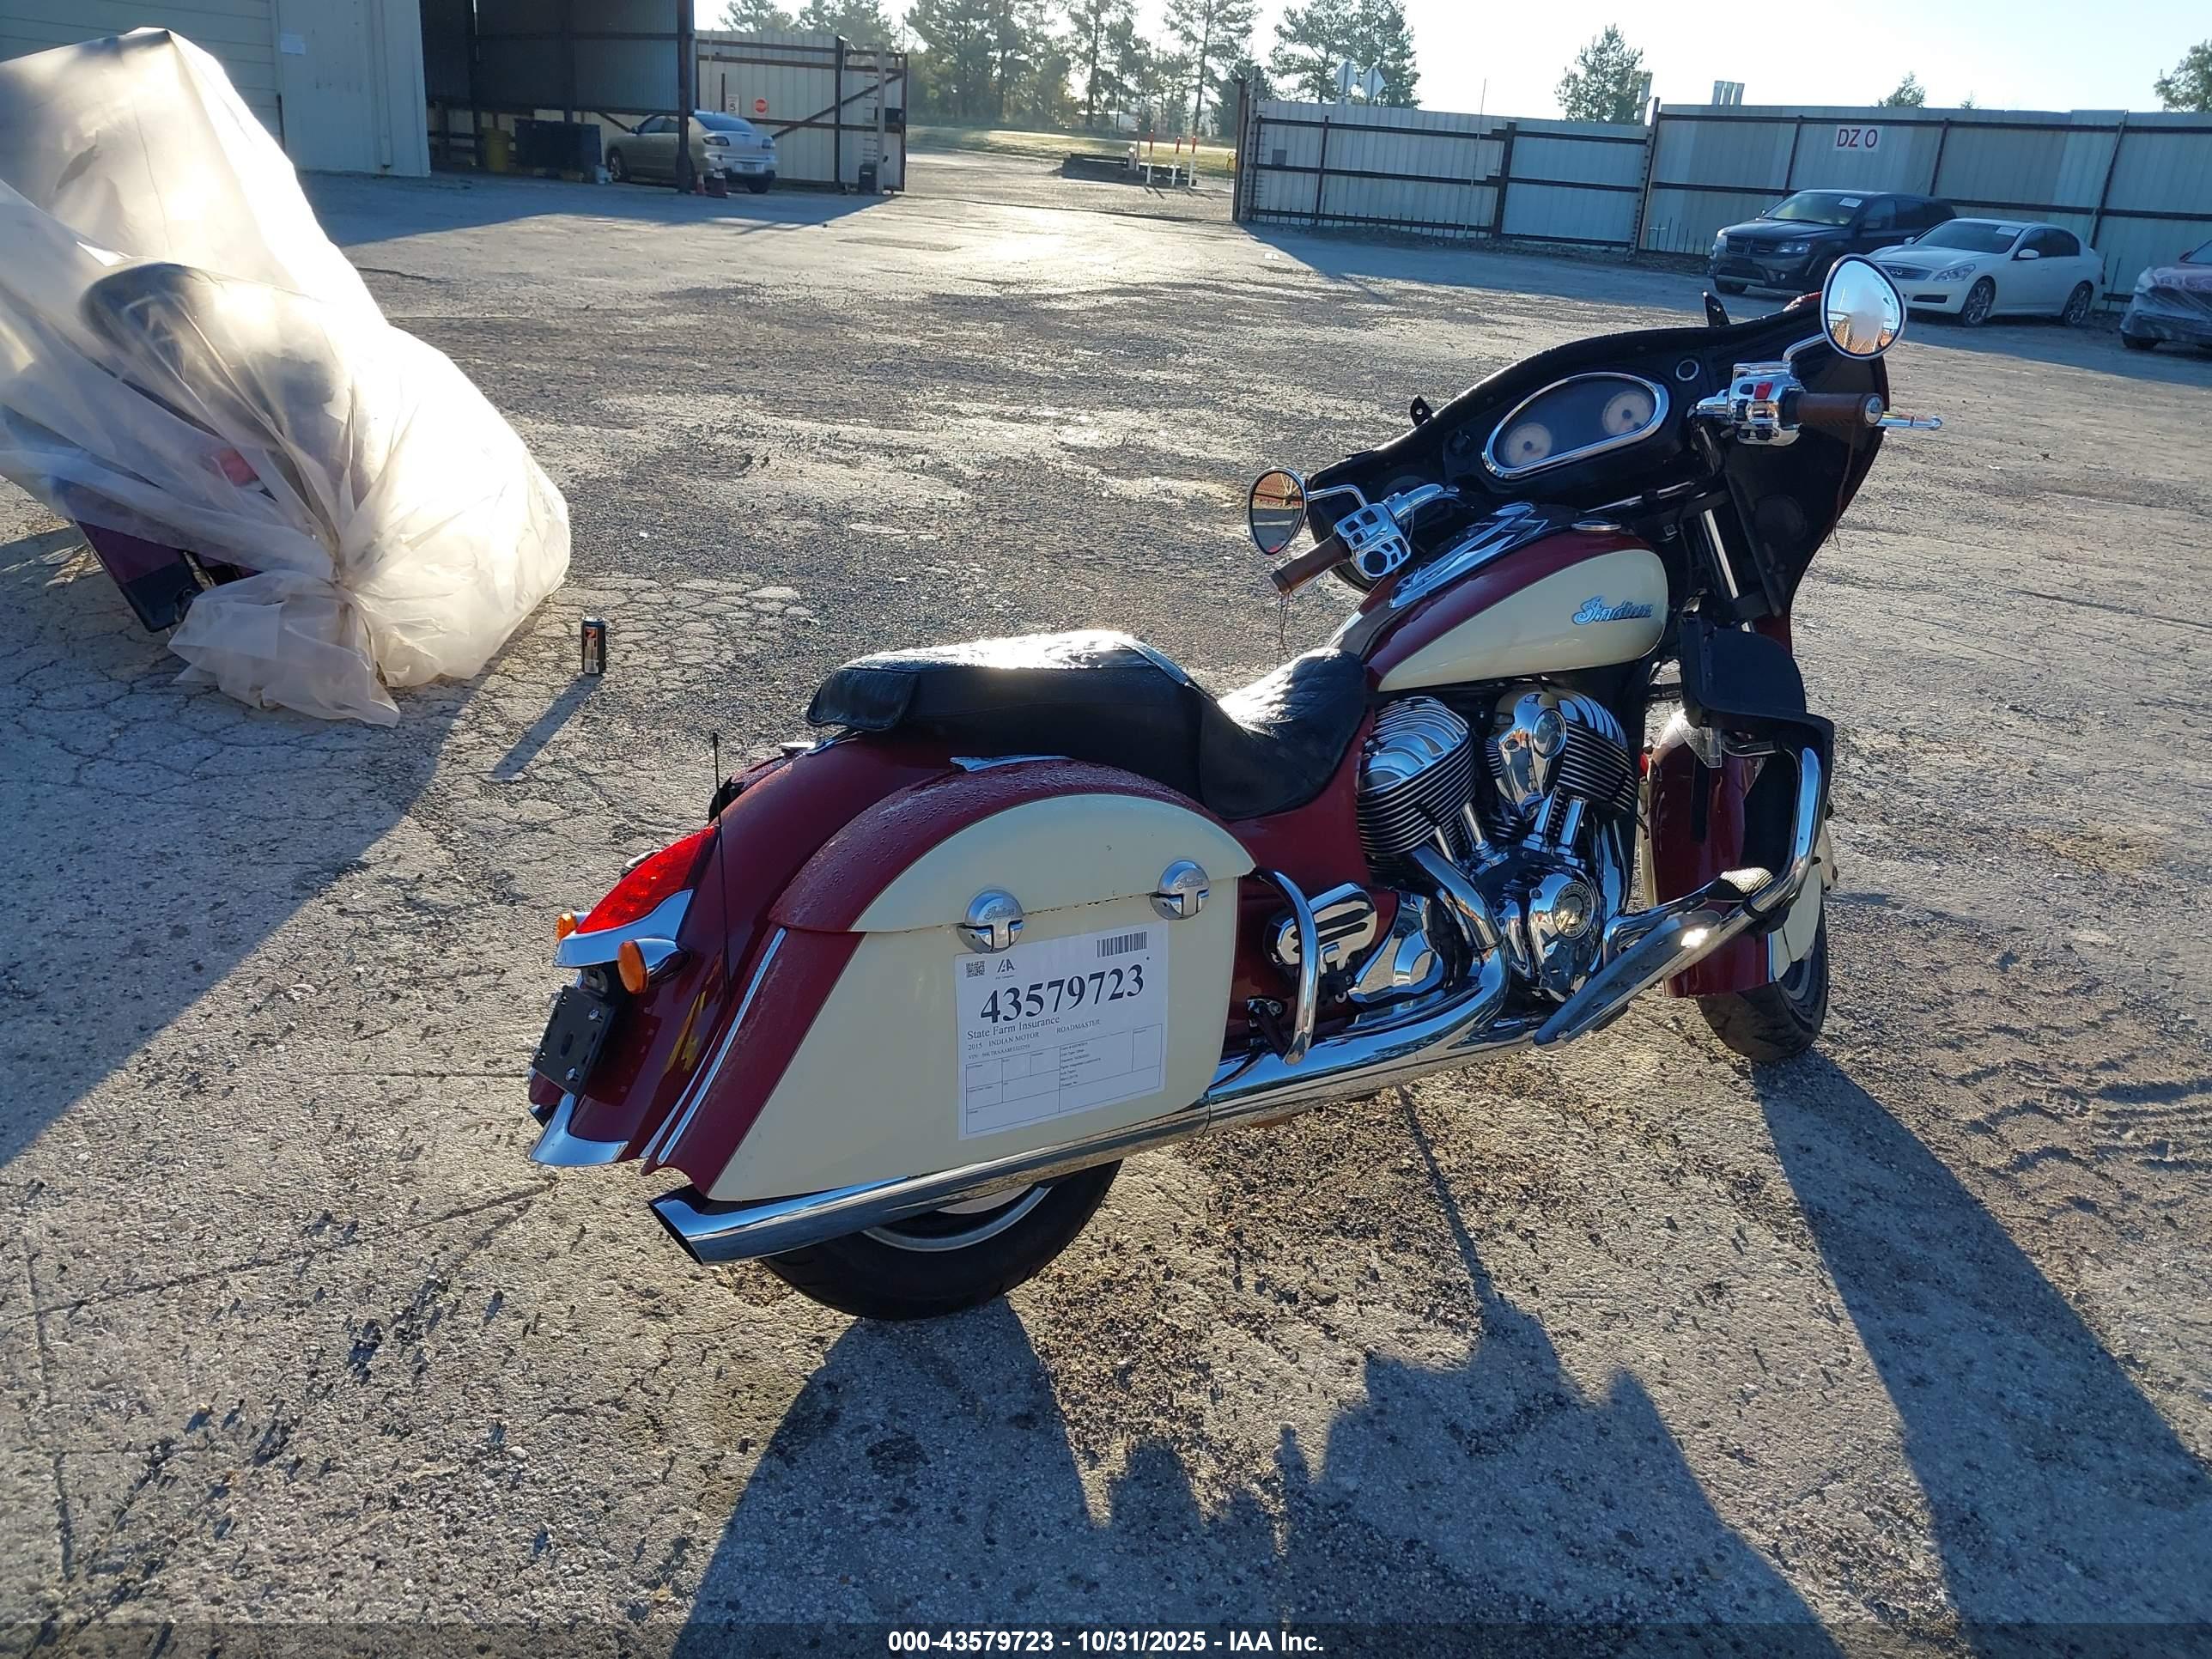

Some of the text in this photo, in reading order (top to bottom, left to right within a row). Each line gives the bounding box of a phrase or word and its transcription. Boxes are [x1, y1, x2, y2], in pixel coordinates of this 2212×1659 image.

[1836, 129, 1862, 148] DZ
[1572, 595, 1654, 626] Indian
[980, 963, 1145, 1024] 43579723
[967, 1016, 1060, 1040] State Farm Insurance
[968, 1042, 982, 1051] 2015
[988, 1034, 1013, 1047] INDIAN
[1013, 1031, 1039, 1042] MOTOR
[1056, 1018, 1100, 1034] ROADMASTER
